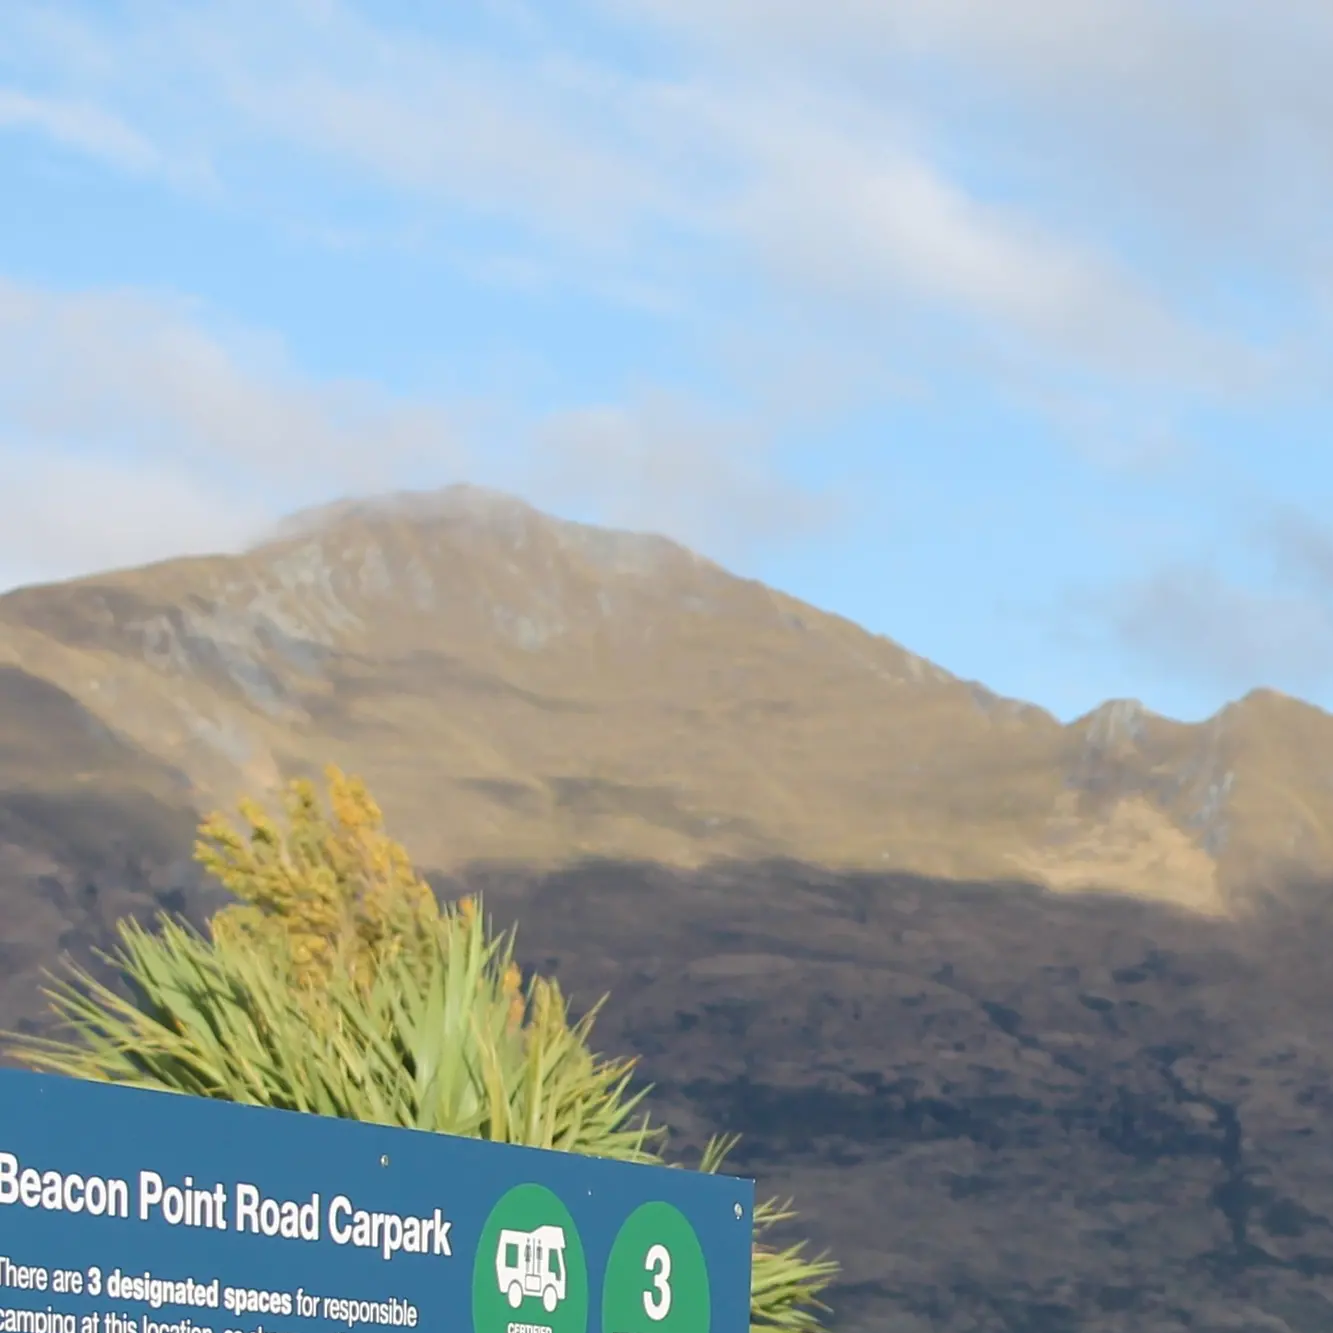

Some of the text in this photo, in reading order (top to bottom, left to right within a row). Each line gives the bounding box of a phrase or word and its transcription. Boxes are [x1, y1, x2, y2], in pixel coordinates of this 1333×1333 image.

[0, 1152, 451, 1260] Beacon Point Road Carpark
[52, 1269, 83, 1294] are
[87, 1266, 101, 1296] 3
[106, 1268, 218, 1308] designated
[223, 1287, 292, 1315] spaces
[295, 1288, 320, 1317] for
[323, 1297, 417, 1327] responsible
[643, 1244, 671, 1320] 3
